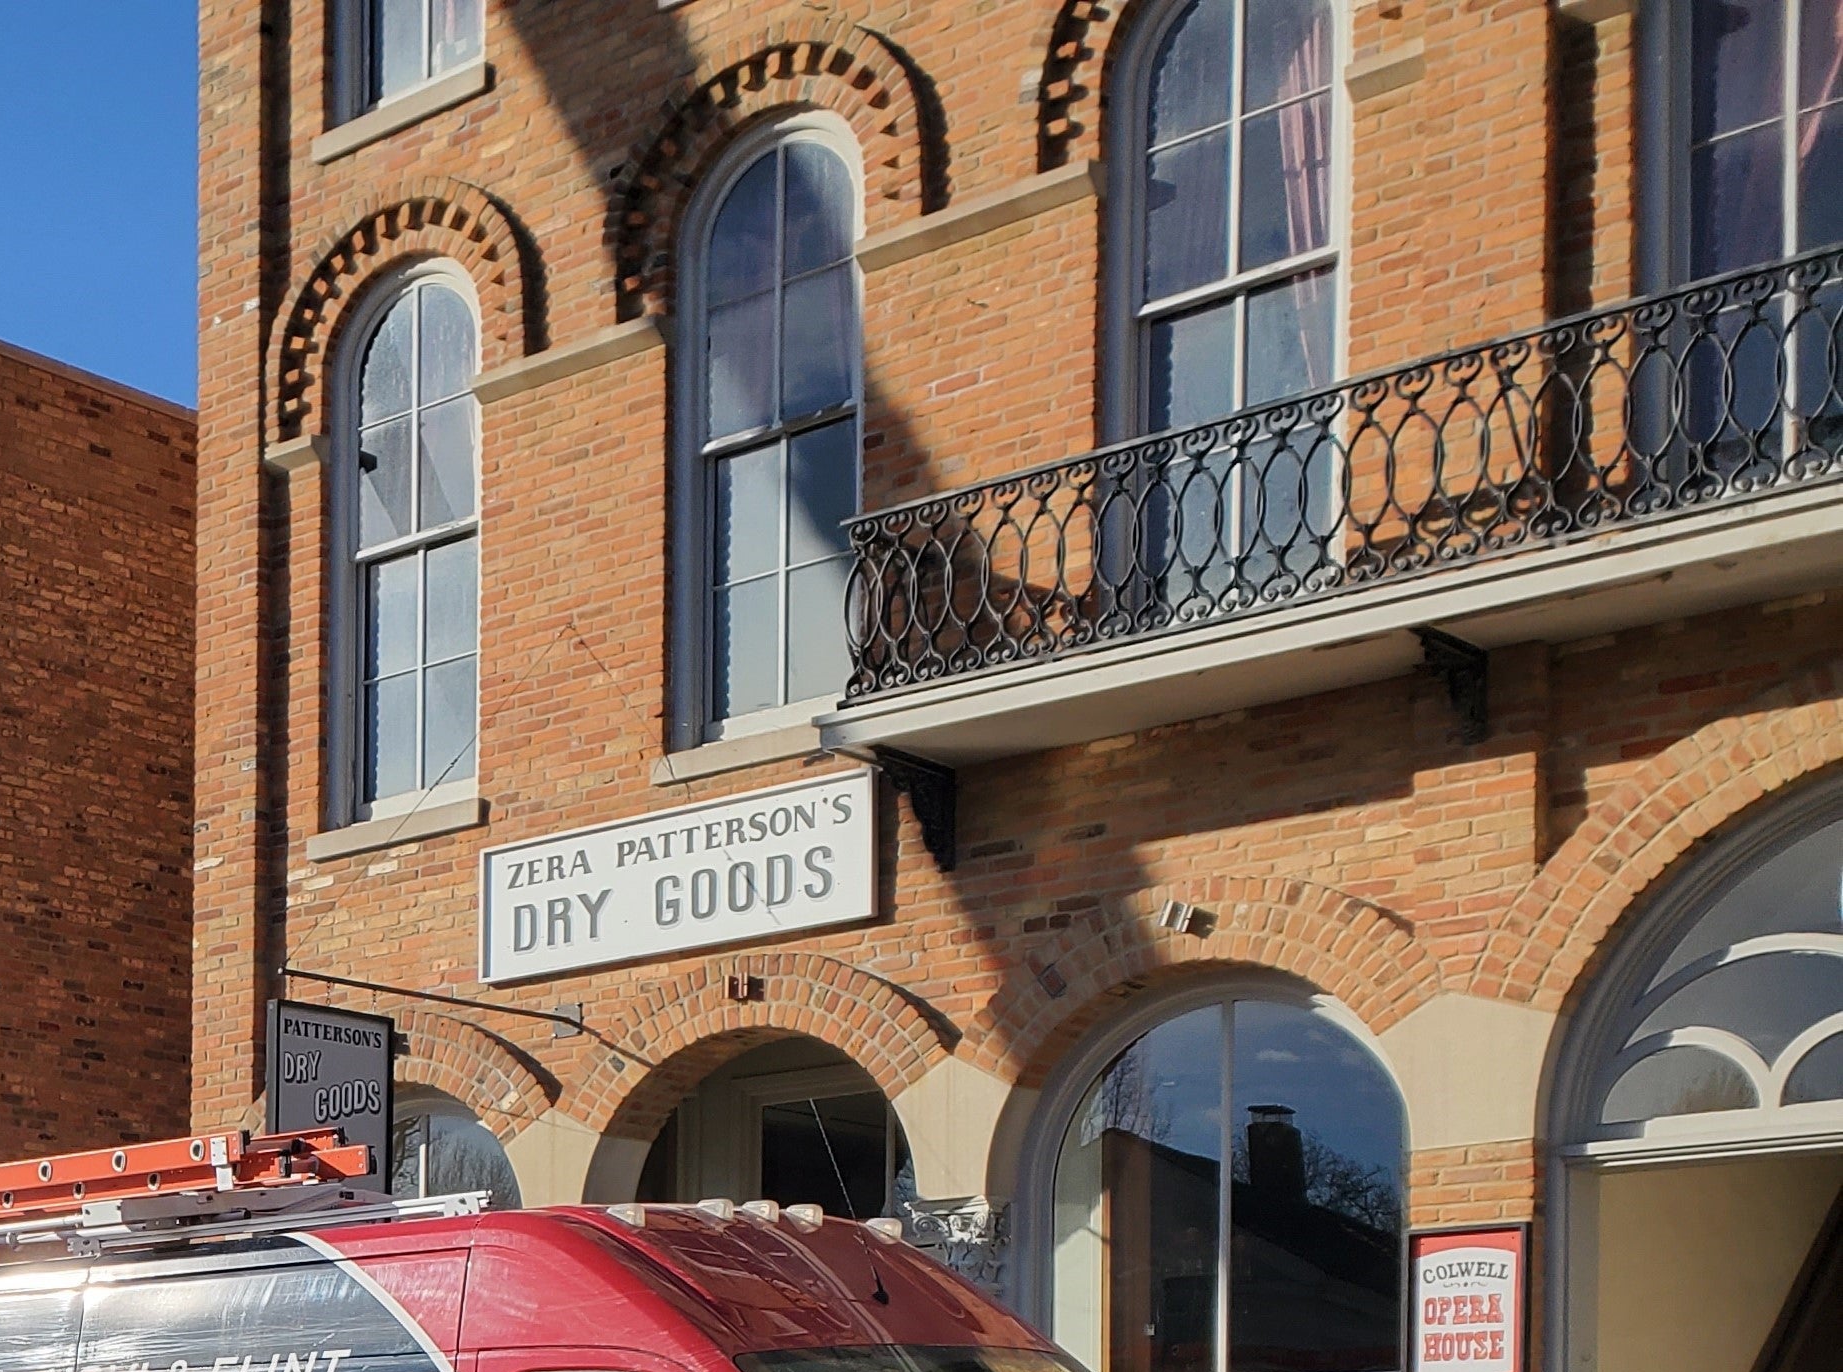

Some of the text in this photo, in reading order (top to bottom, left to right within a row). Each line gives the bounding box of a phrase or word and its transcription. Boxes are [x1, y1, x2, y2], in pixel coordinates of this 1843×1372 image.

[506, 793, 853, 890] ZERA PATTERSON'S
[513, 844, 836, 953] DRY GOODS
[284, 1018, 382, 1049] PATTERSON'S
[284, 1050, 321, 1084] DRY
[314, 1080, 381, 1123] GOODS
[1423, 1261, 1509, 1284] COLWELL
[1424, 1293, 1504, 1325] OPERA
[1424, 1330, 1505, 1362] HOUSE
